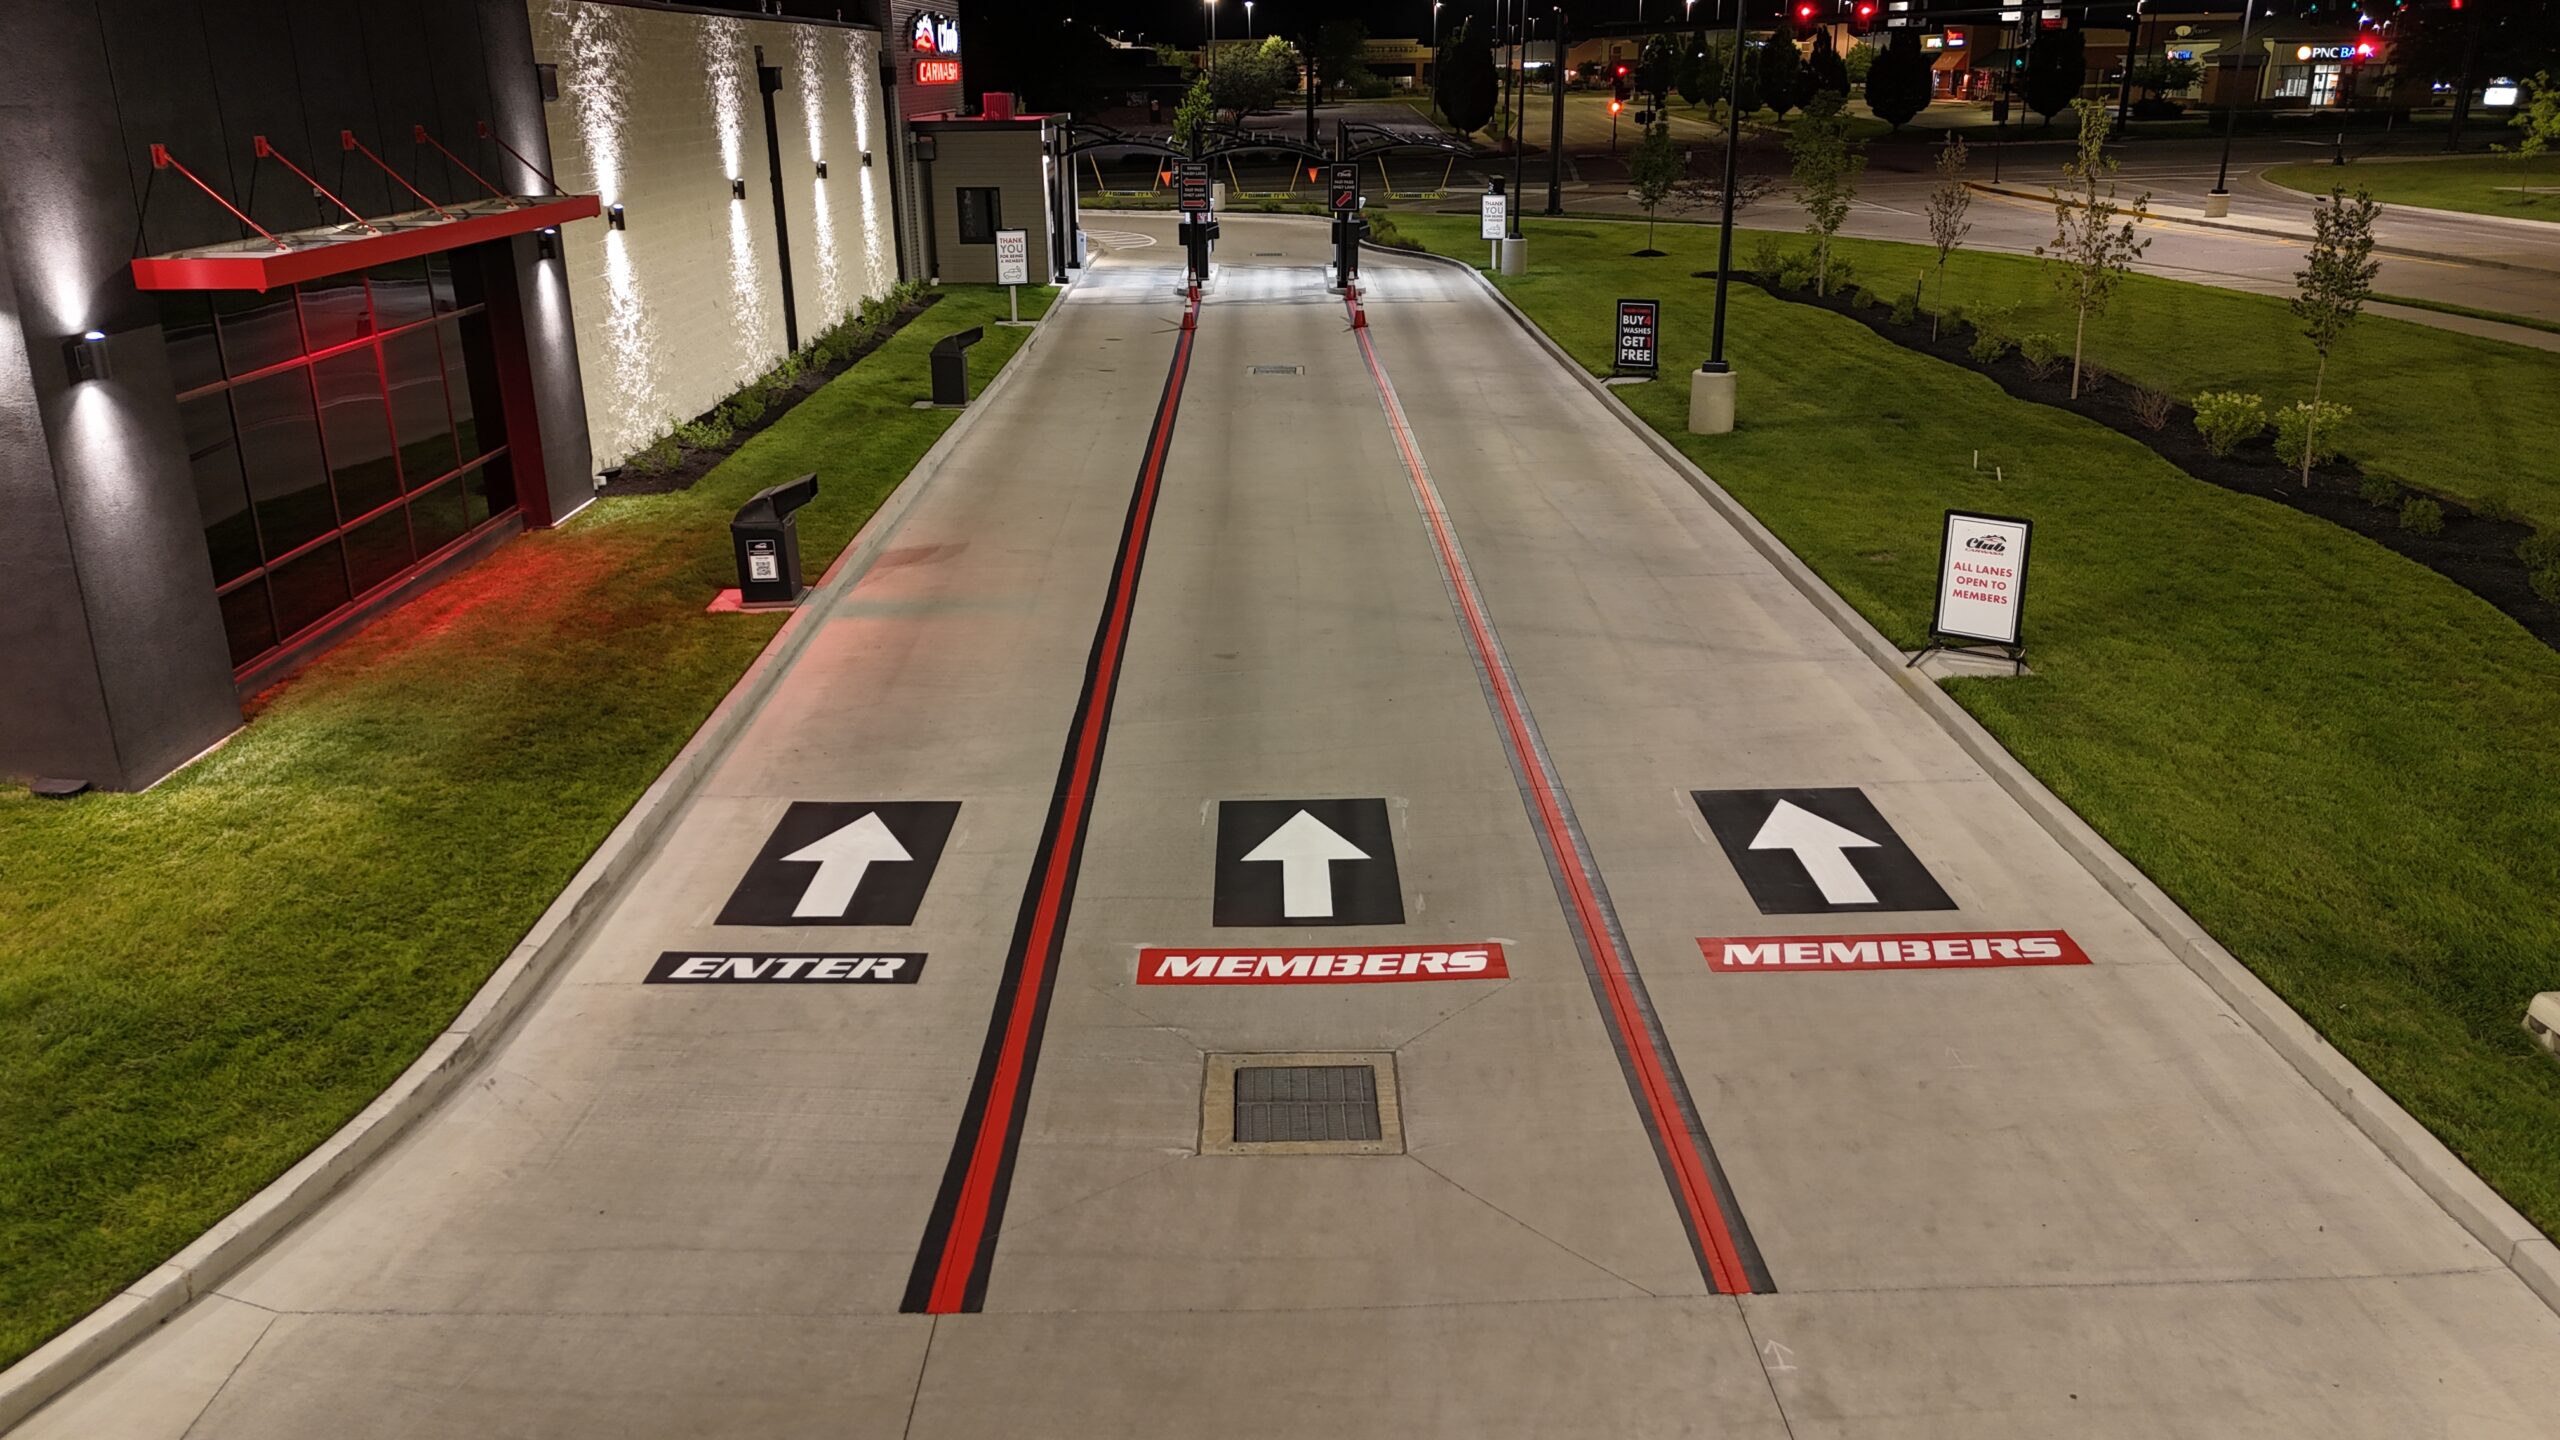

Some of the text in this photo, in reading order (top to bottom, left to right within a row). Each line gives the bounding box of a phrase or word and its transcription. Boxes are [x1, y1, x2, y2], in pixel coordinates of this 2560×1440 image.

[2312, 47, 2375, 58] PNC BAK
[920, 62, 958, 81] CARWASH
[1485, 206, 1503, 214] YOU
[1000, 244, 1024, 254] YOU
[1623, 314, 1651, 325] BUY 4
[1623, 326, 1651, 334] WASHES
[1622, 335, 1651, 347] GET 1
[1621, 348, 1651, 361] FREE
[1966, 537, 2005, 552] Club
[1953, 561, 2013, 577] ALL LANES
[1956, 575, 2007, 590] OPEN TO
[1952, 588, 2008, 604] MEMBERS
[1721, 937, 2062, 965] MEMBERS
[667, 957, 906, 979] ENTER
[1154, 950, 1489, 977] MEMBERS
